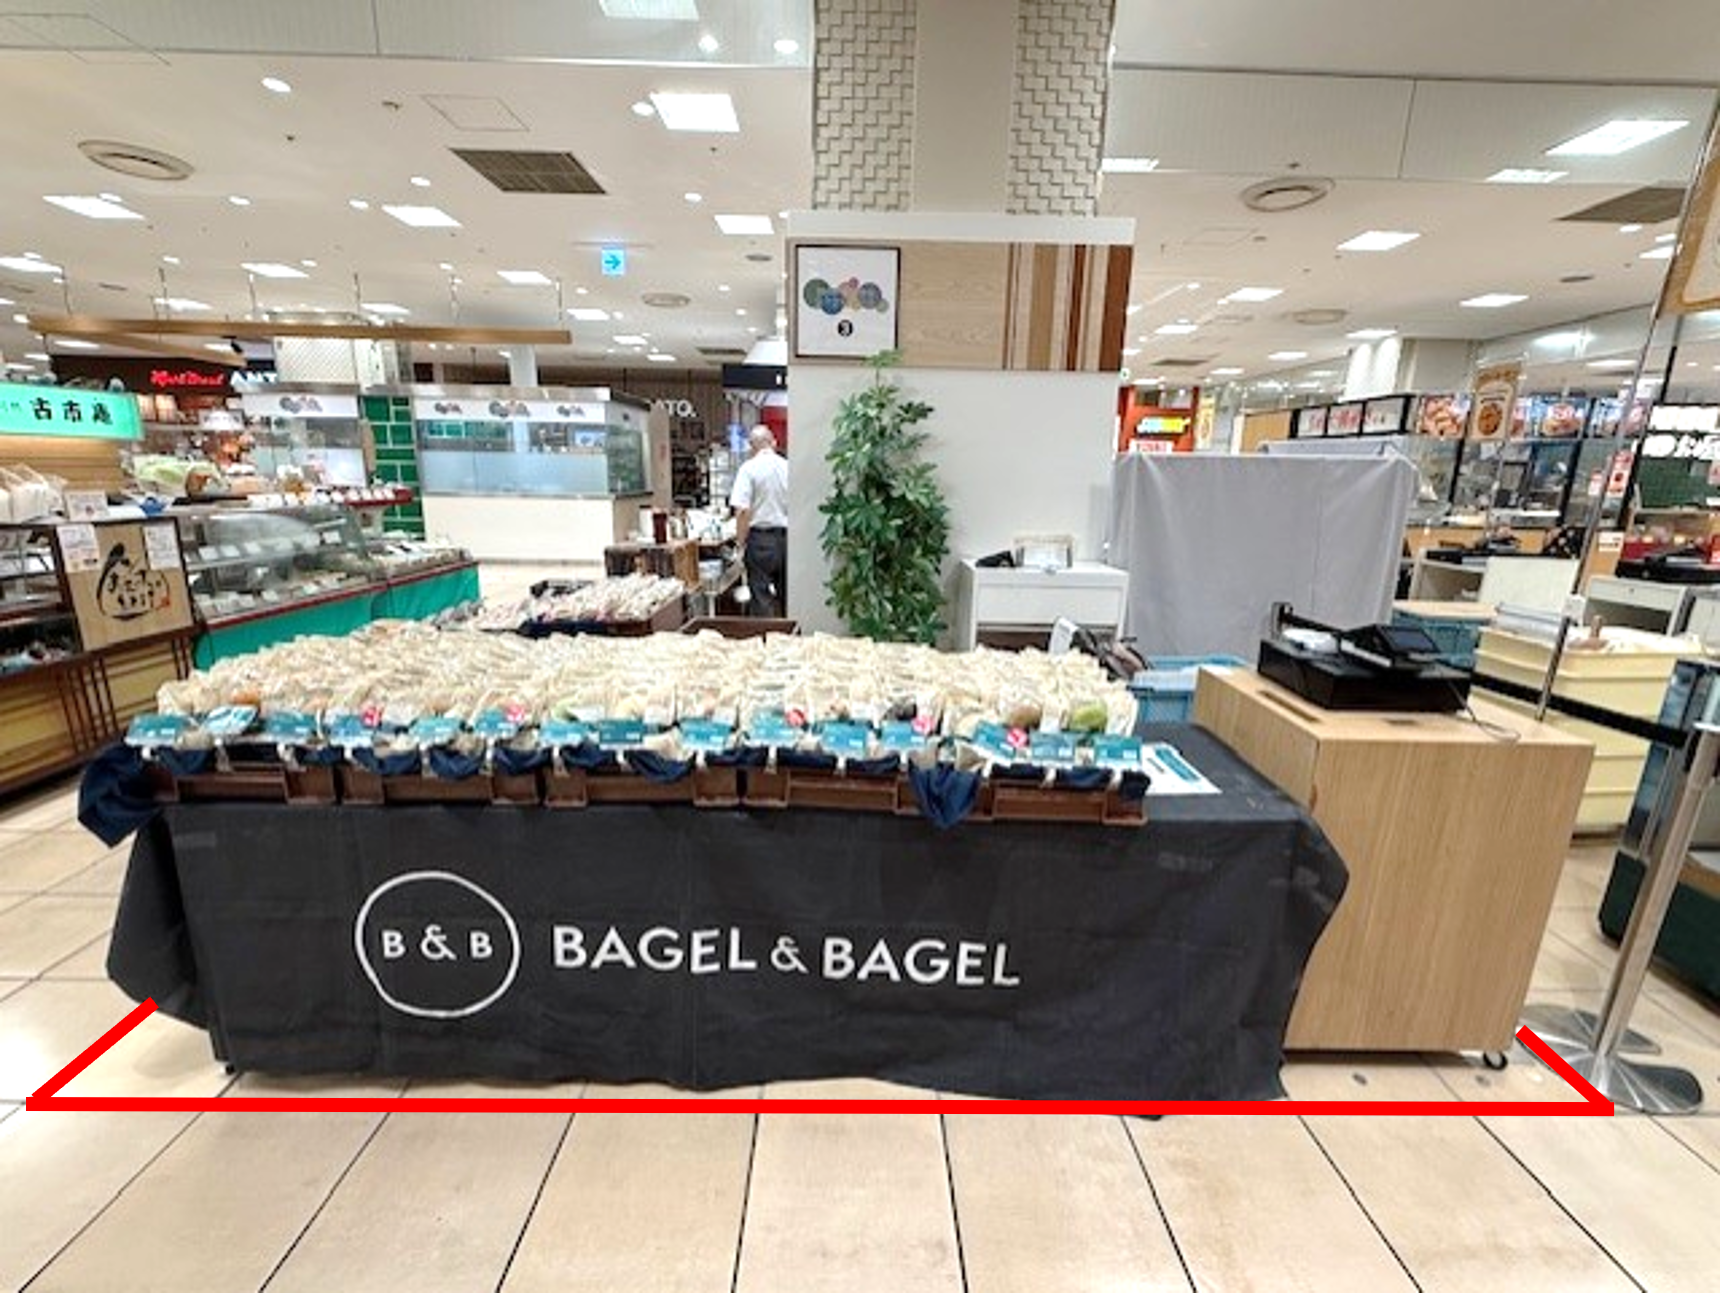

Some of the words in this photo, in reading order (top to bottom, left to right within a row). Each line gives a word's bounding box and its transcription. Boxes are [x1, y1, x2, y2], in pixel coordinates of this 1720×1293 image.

[382, 931, 406, 957] B
[420, 925, 456, 960] &
[470, 931, 493, 958] B
[553, 926, 757, 974] BAGEL
[770, 937, 807, 974] &
[823, 937, 1020, 987] BAGEL
